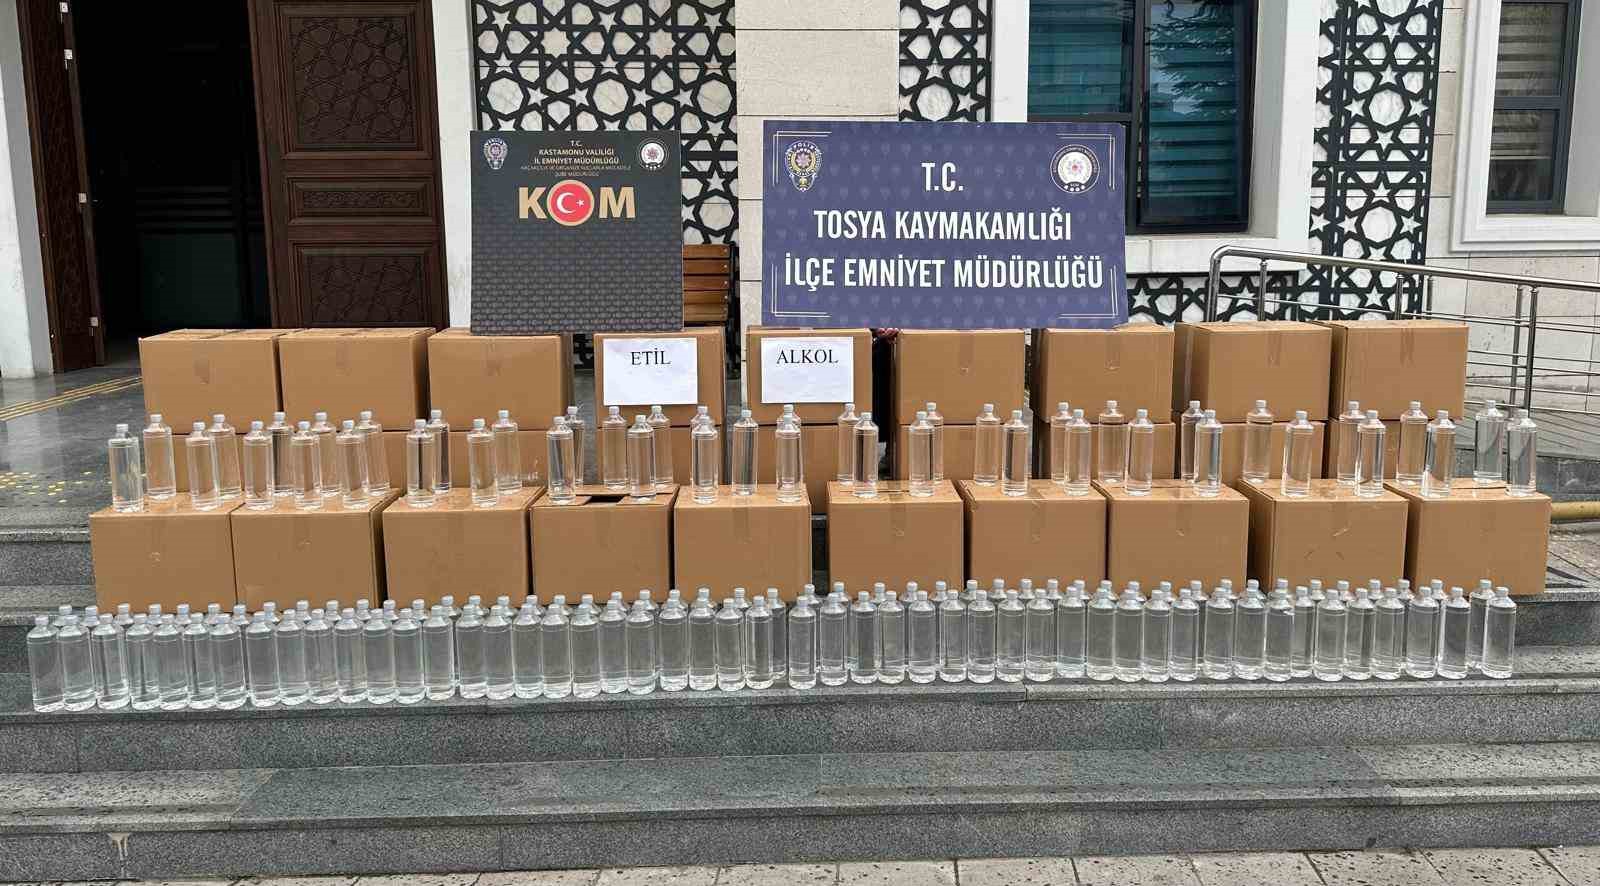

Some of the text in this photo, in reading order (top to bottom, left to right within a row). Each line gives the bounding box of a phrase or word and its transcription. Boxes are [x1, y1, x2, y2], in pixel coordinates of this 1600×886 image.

[541, 157, 573, 165] EMNİYET
[921, 162, 964, 192] T.C.
[518, 179, 636, 227] KOM
[813, 207, 1071, 241] TOSYA KAYMAKAMLIĞI
[785, 253, 1103, 292] İLÇE EMNİYET MÜDÜRLÜĞÜ
[631, 347, 671, 366] ETİL
[776, 349, 839, 365] ALKOL
